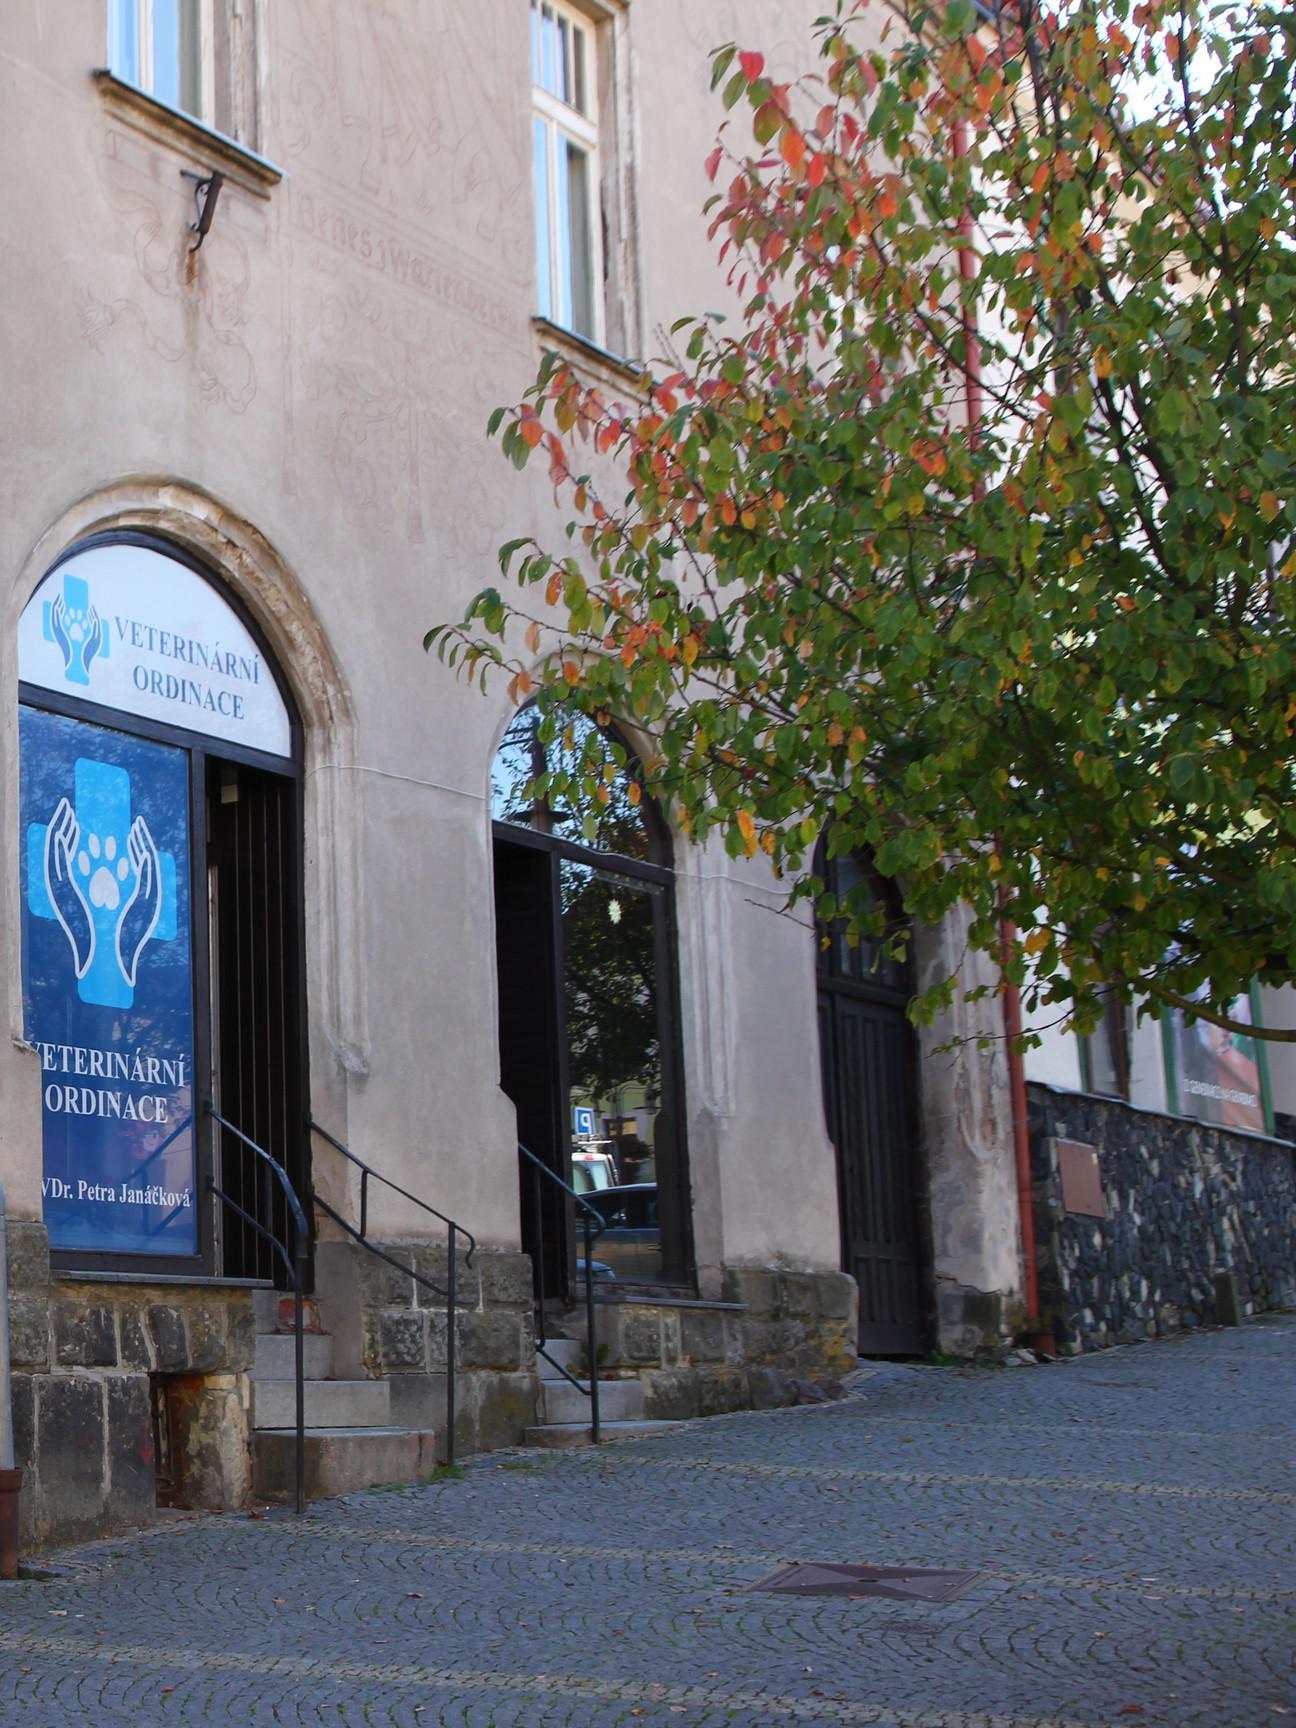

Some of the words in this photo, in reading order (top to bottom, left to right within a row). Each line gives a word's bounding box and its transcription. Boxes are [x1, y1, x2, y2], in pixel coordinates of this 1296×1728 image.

[114, 616, 260, 685] VETERINÁRNÍ
[133, 665, 245, 720] ORDINACE
[44, 1084, 168, 1124] ORDINACE
[77, 1179, 116, 1202] Petra
[119, 1183, 190, 1207] Janáčková
